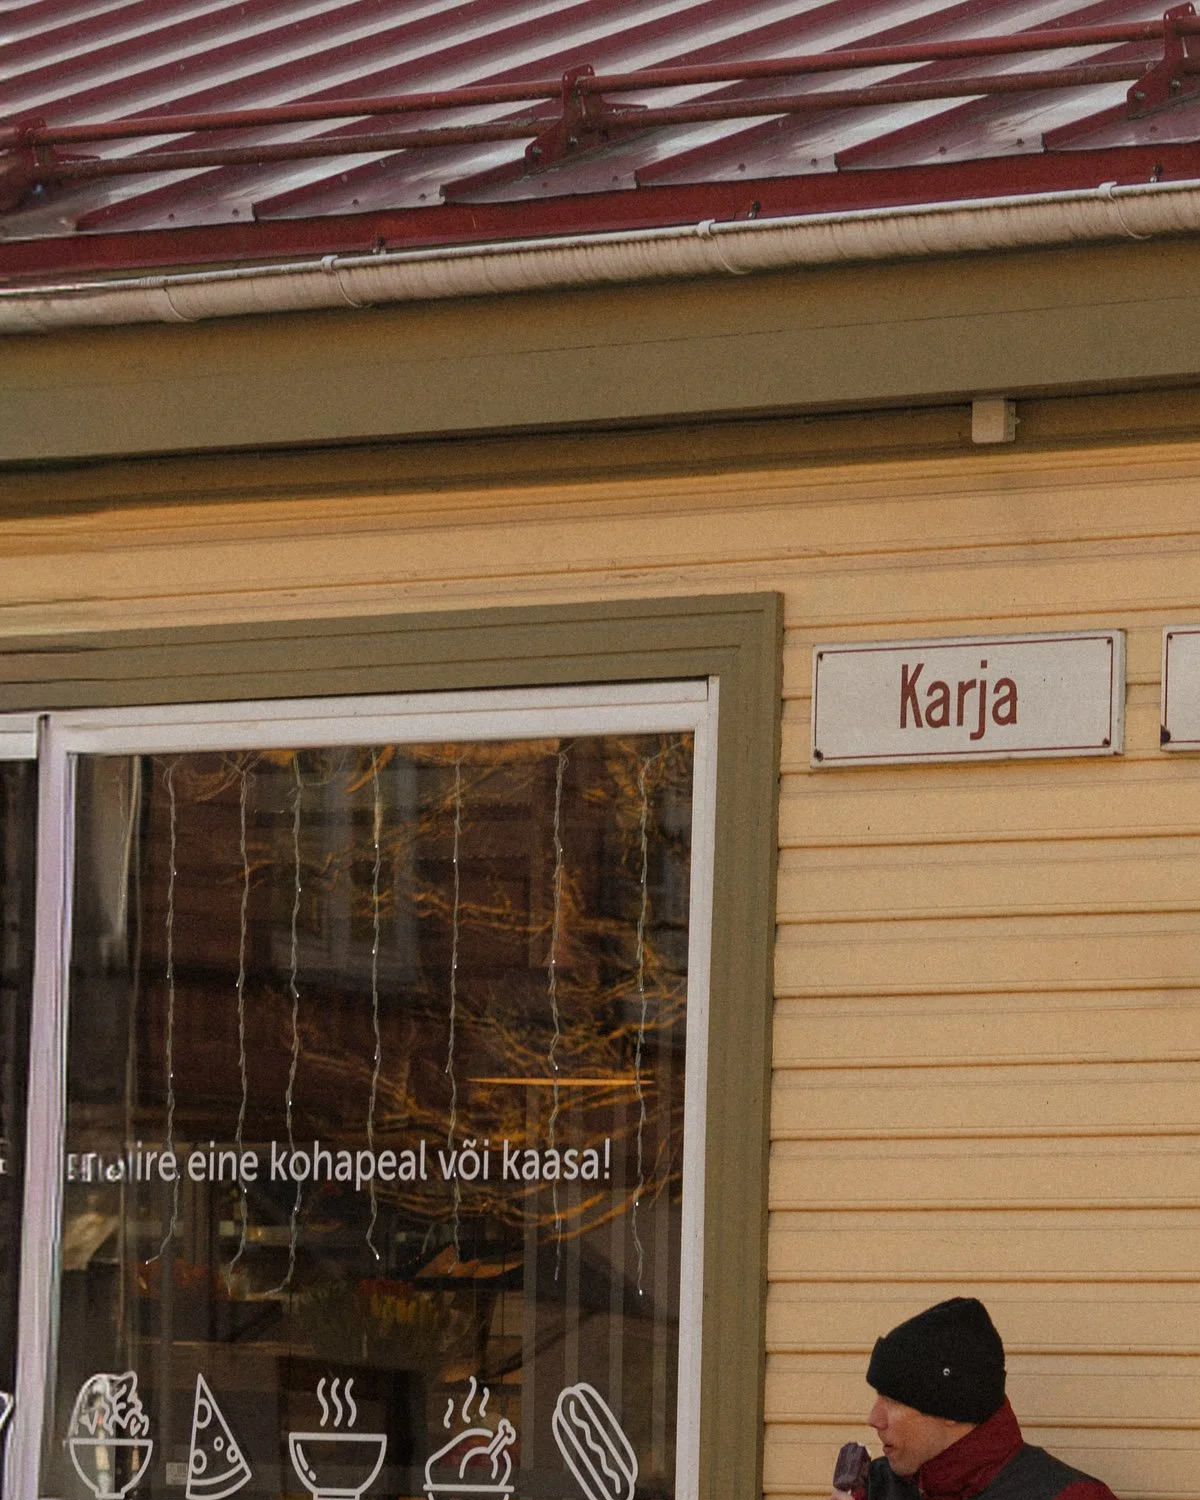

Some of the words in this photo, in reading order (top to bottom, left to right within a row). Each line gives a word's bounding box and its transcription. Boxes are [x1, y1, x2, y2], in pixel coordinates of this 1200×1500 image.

[899, 660, 1018, 741] Karja
[187, 1140, 259, 1182] eine
[271, 1139, 428, 1192] kohapeal
[438, 1138, 490, 1181] või
[502, 1137, 611, 1181] kaasa!
